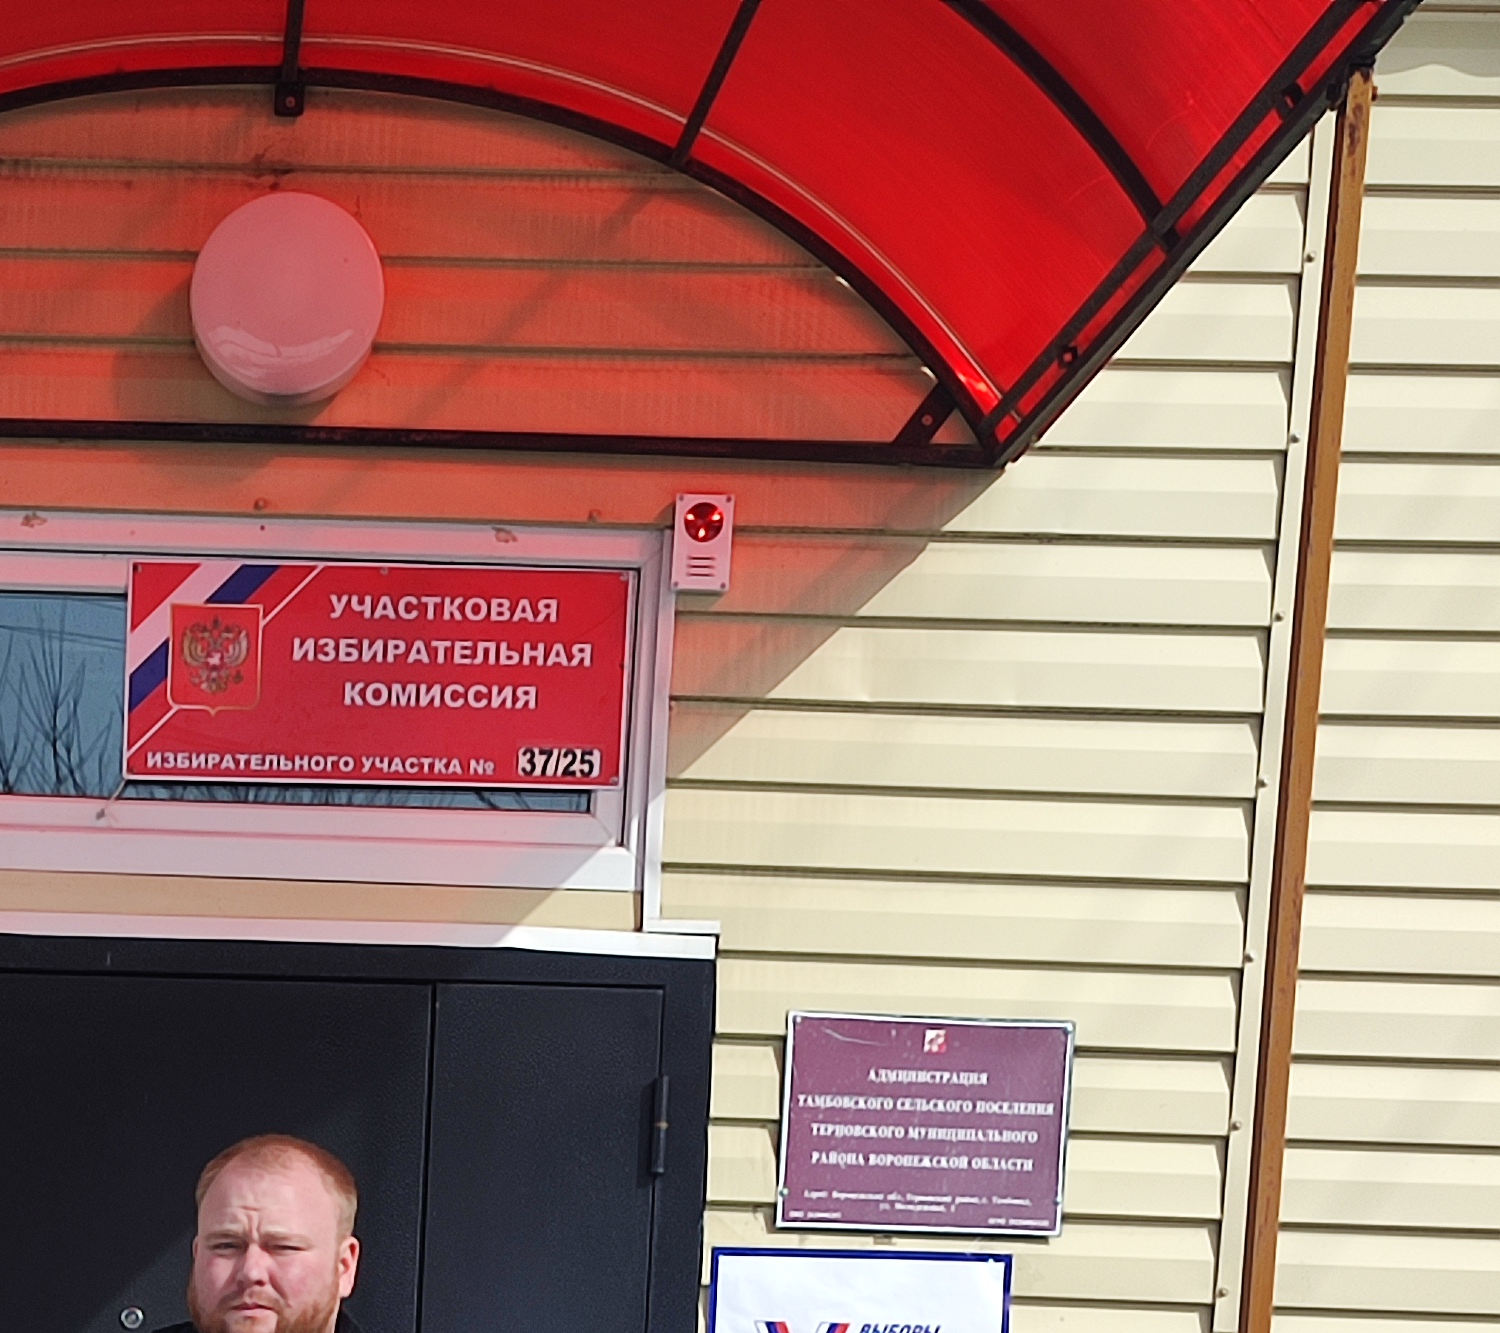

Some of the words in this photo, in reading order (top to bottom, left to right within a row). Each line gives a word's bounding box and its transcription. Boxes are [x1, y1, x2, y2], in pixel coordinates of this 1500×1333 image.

[329, 594, 558, 623] УЧАСТКОВАЯ
[292, 637, 592, 668] ИЗБИРАТЕЛЬНАЯ
[343, 682, 538, 710] КОМИССИЯ
[146, 751, 355, 774] ИЗБИРАТЕЛЬНОГО
[360, 756, 463, 776] УЧАСТКА
[519, 747, 596, 778] 37/25
[867, 1067, 988, 1086] АДМИНИСТРАЦИЯ
[797, 1093, 894, 1111] ТАМБОВСКОГО
[896, 1097, 973, 1114] СЕЛЬСКОГО
[975, 1100, 1055, 1116] ПОСЕЛЕНИЯ
[811, 1122, 905, 1139] ТЕРНОВСКОГО
[908, 1126, 1038, 1144] МУНИЦИПАЛЬНОГО
[868, 1151, 969, 1169] ВОРОНЕЖСКОЙ
[971, 1155, 1033, 1171] ОБЛАСТИ
